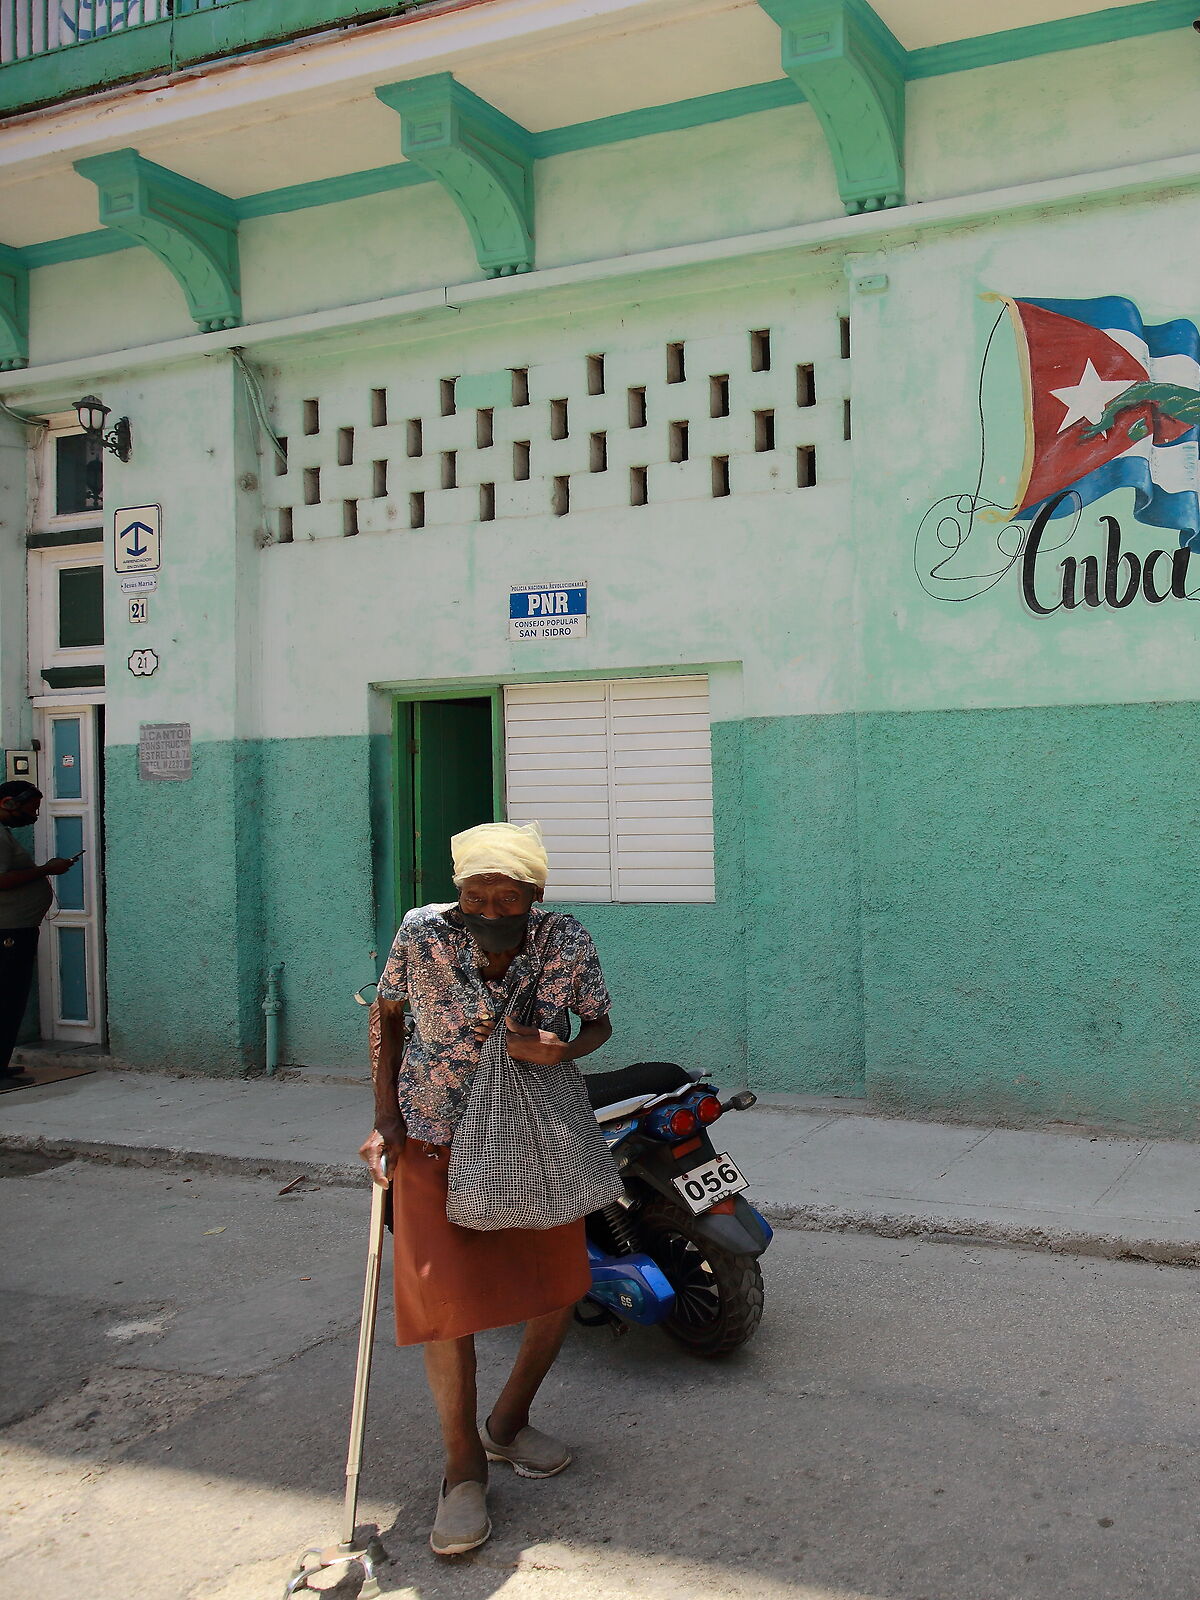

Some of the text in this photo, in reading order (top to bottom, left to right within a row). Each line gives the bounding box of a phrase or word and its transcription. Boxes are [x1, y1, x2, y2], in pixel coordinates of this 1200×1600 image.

[1020, 490, 1191, 614] Cuba
[131, 603, 145, 618] 21
[527, 592, 569, 616] PNR
[514, 617, 579, 628] CONSEJO POPULAR
[519, 627, 572, 638] SAN ISIDRO
[137, 656, 148, 669] 21
[141, 750, 180, 761] ESTRELLA
[684, 1163, 738, 1202] 056
